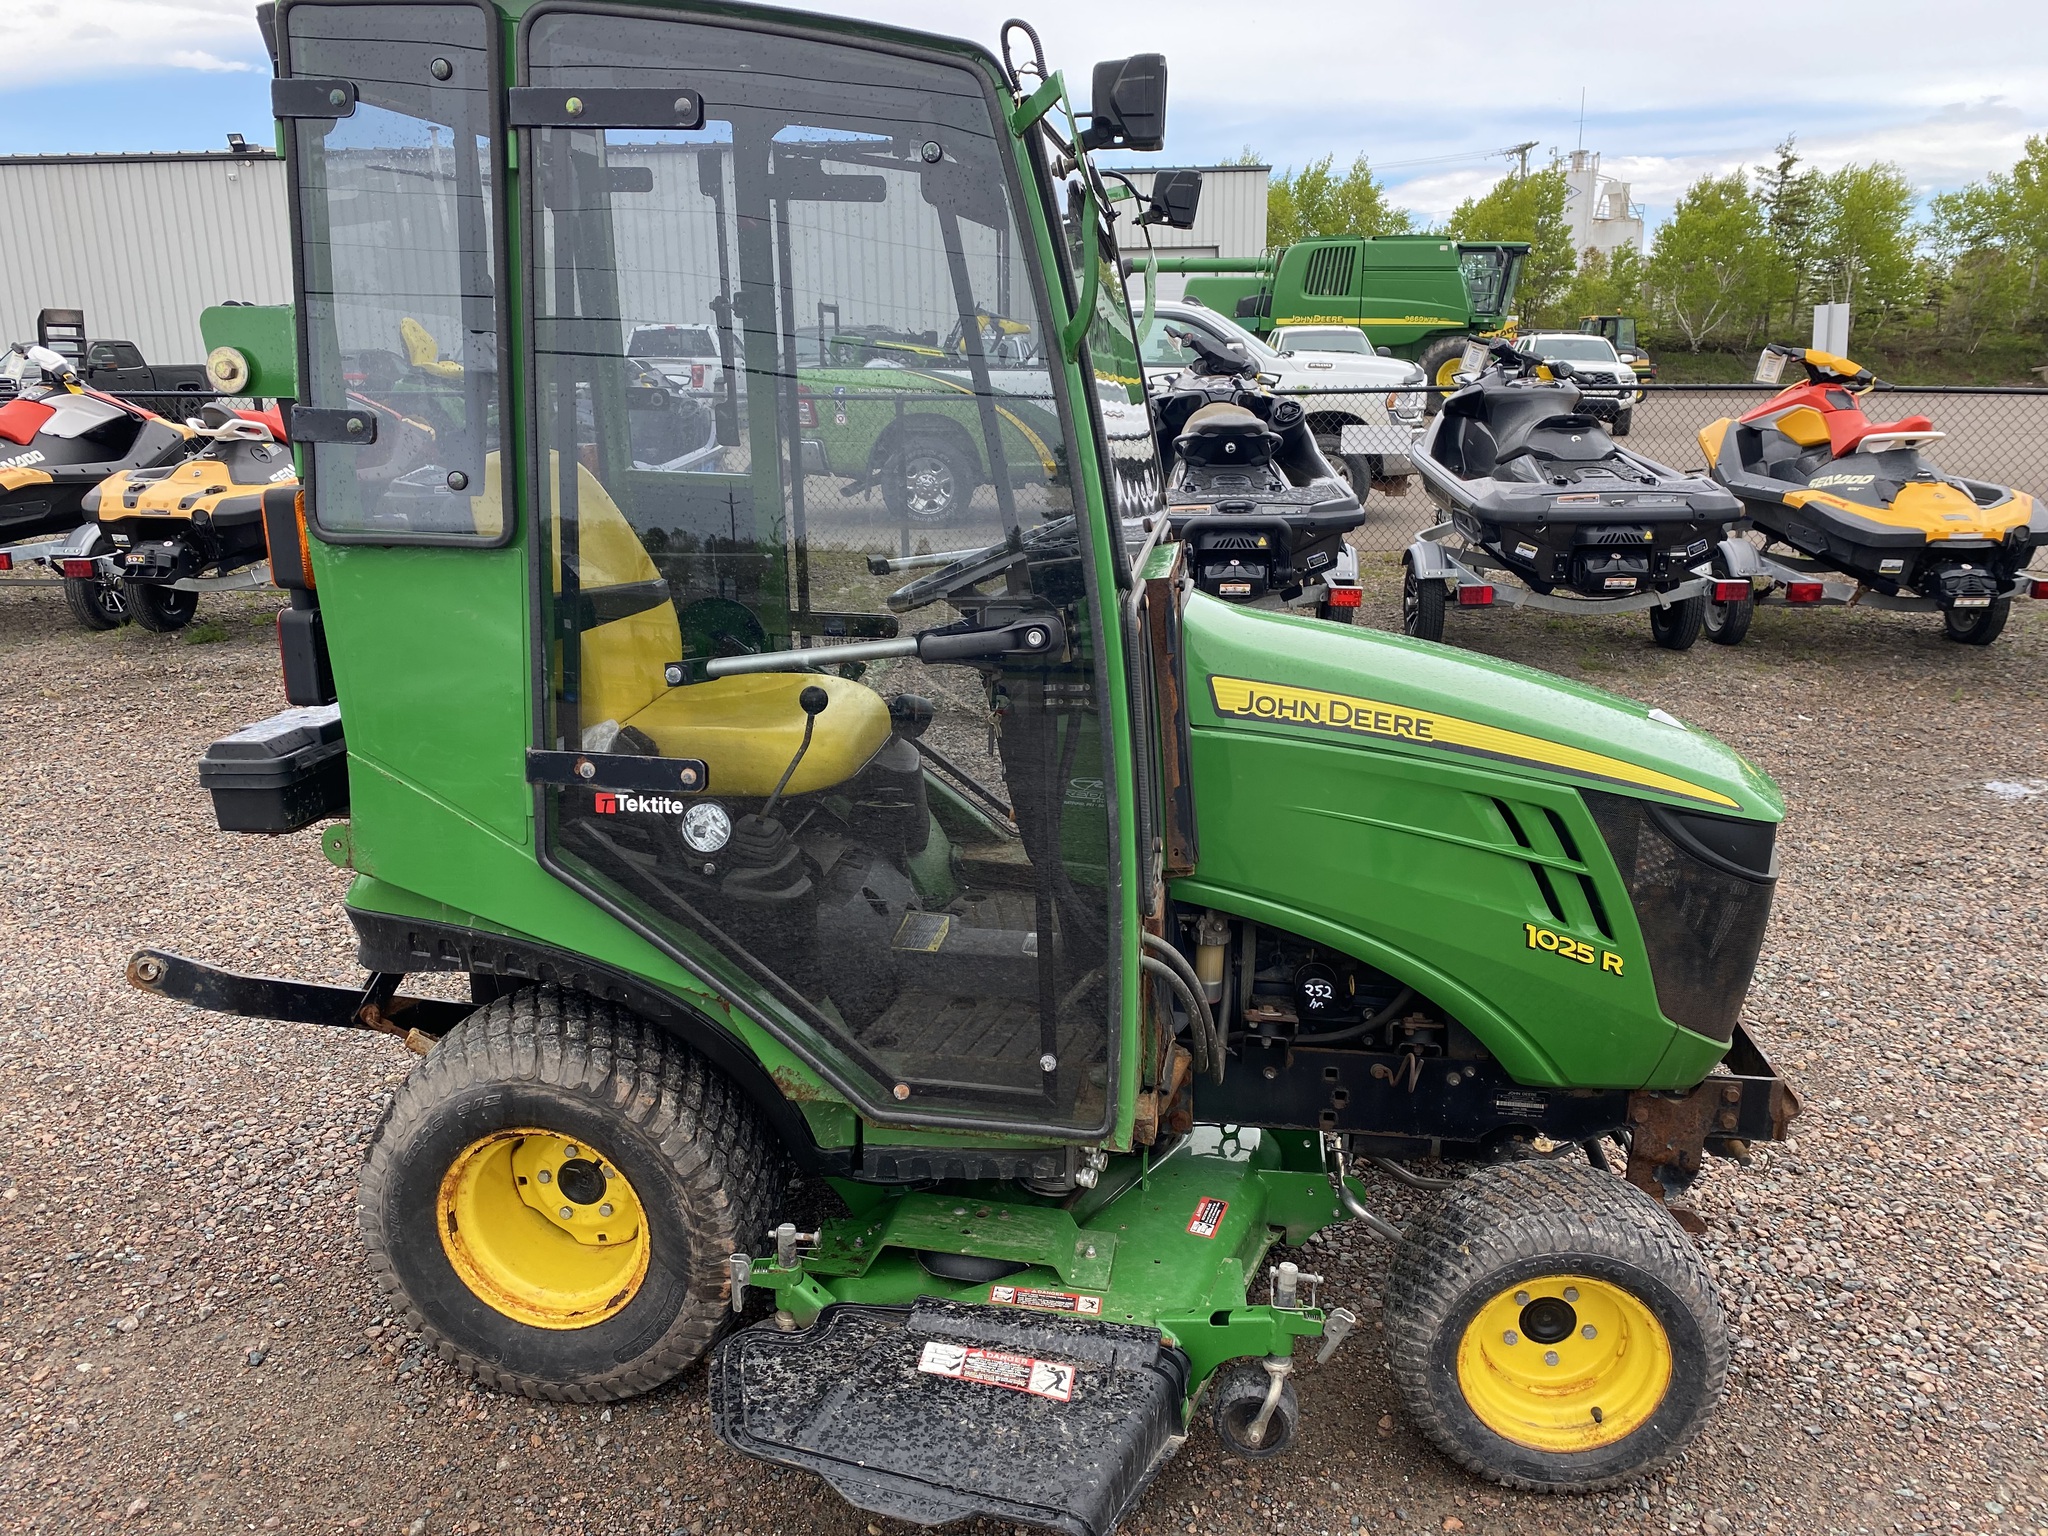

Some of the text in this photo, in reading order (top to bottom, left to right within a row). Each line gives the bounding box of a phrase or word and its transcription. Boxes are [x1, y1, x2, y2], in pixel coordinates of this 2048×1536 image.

[1290, 315, 1344, 324] JOHN DEERE
[1237, 690, 1434, 740] JOHN DEERE
[614, 794, 684, 815] Tektite
[1523, 922, 1625, 977] 1025 R
[1304, 984, 1333, 999] 252
[1037, 1289, 1065, 1297] DANGER
[986, 1352, 1028, 1365] DANGER
